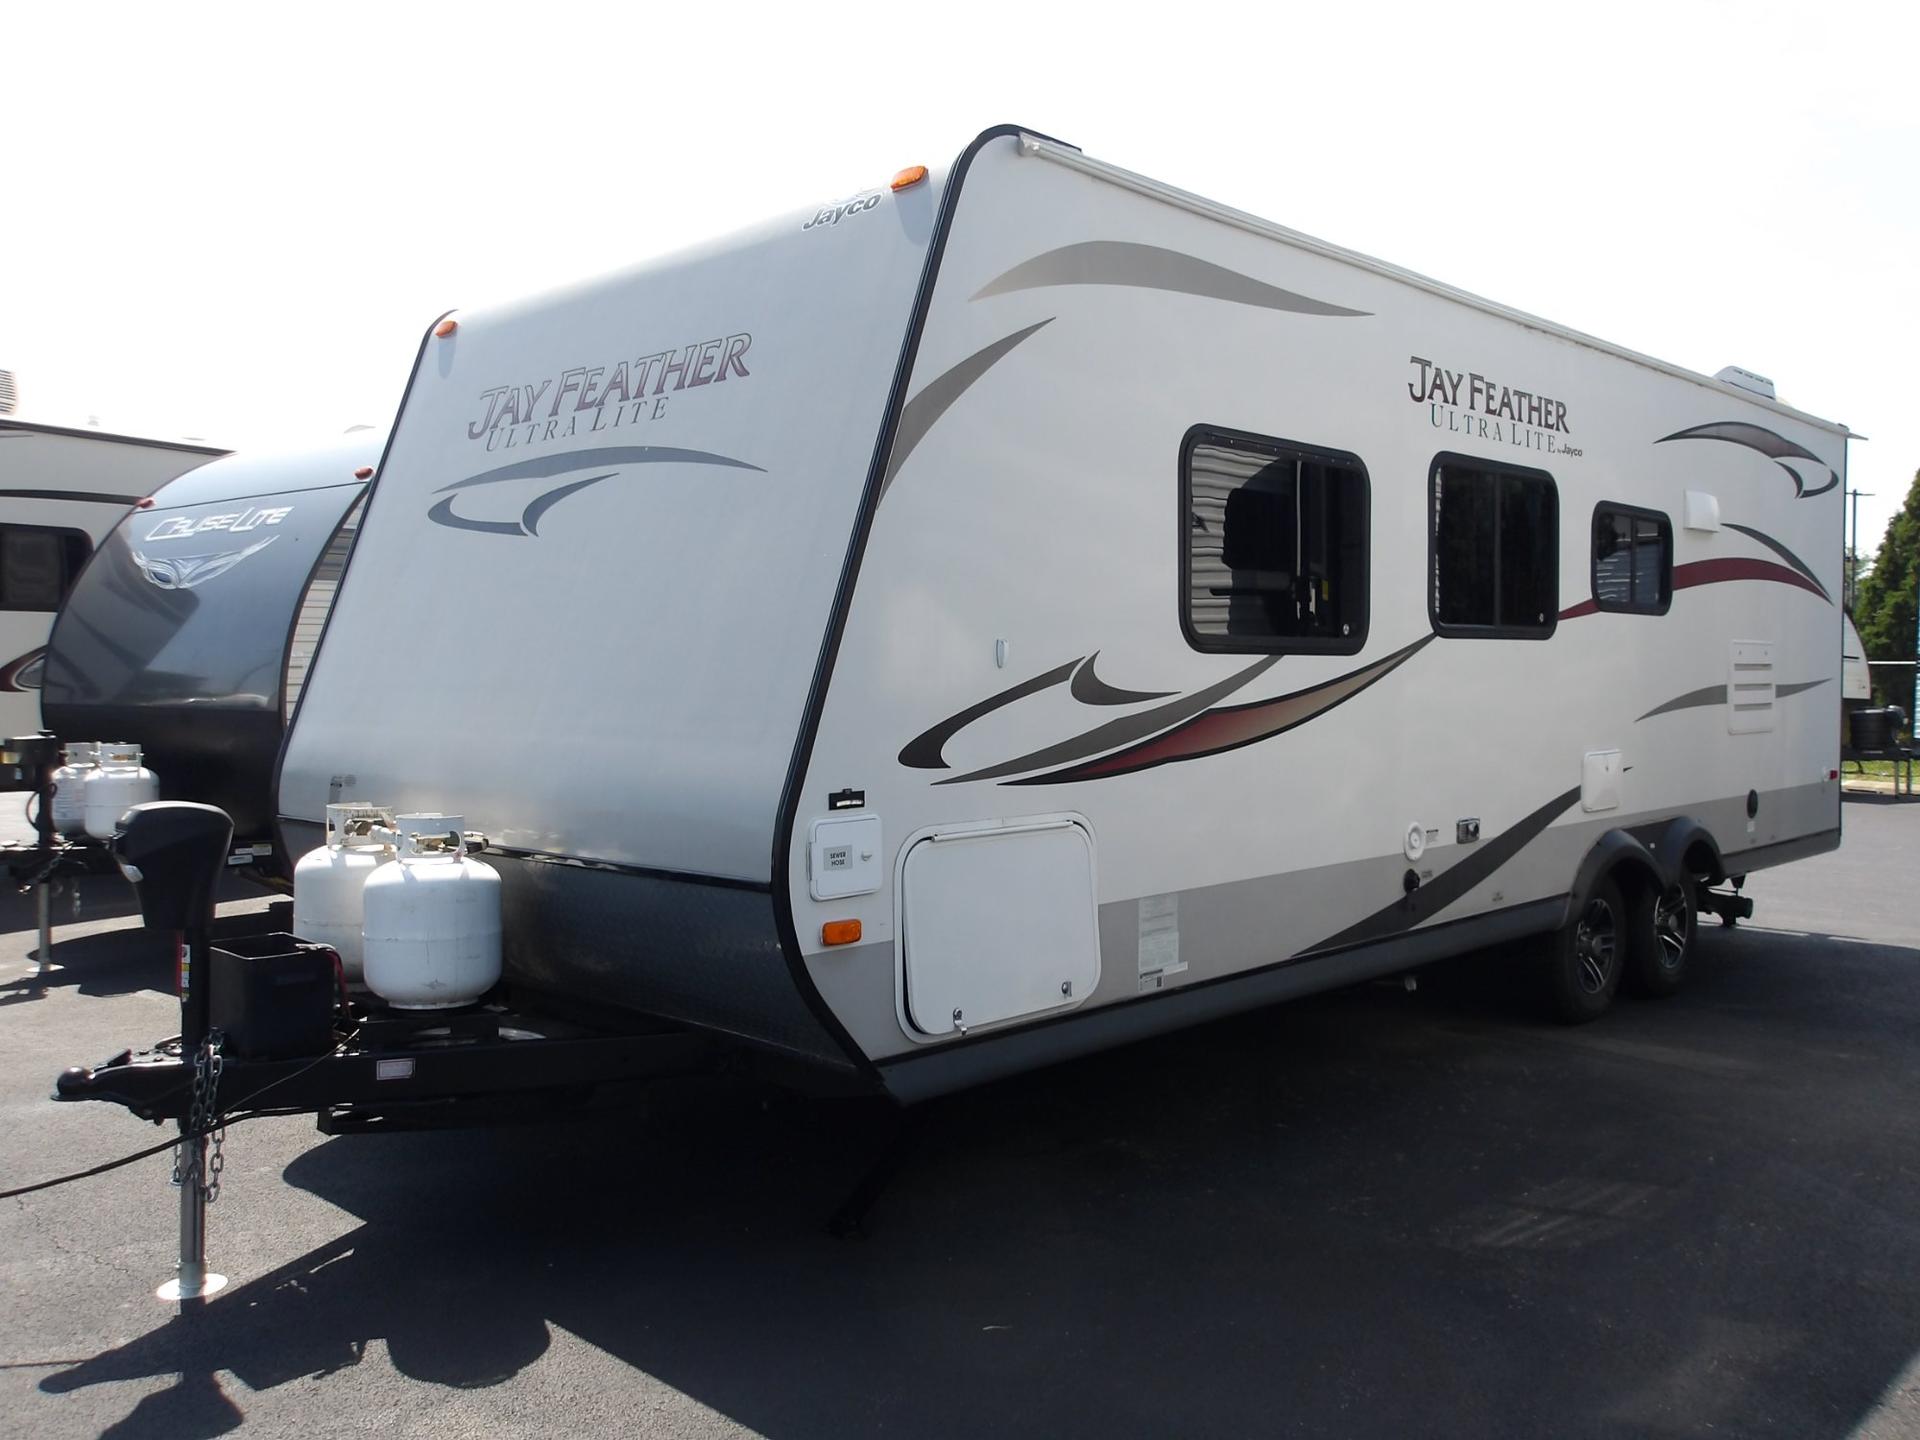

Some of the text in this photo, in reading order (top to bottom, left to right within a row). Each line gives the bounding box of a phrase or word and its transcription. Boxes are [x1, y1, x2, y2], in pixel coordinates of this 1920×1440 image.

[803, 194, 881, 230] Jayco
[468, 333, 752, 440] JAY FEATHER
[1408, 355, 1570, 433] JAY FEATHER
[485, 396, 669, 451] ULTRA LITE
[1430, 403, 1503, 442] ULTRA
[1511, 423, 1556, 453] LITE
